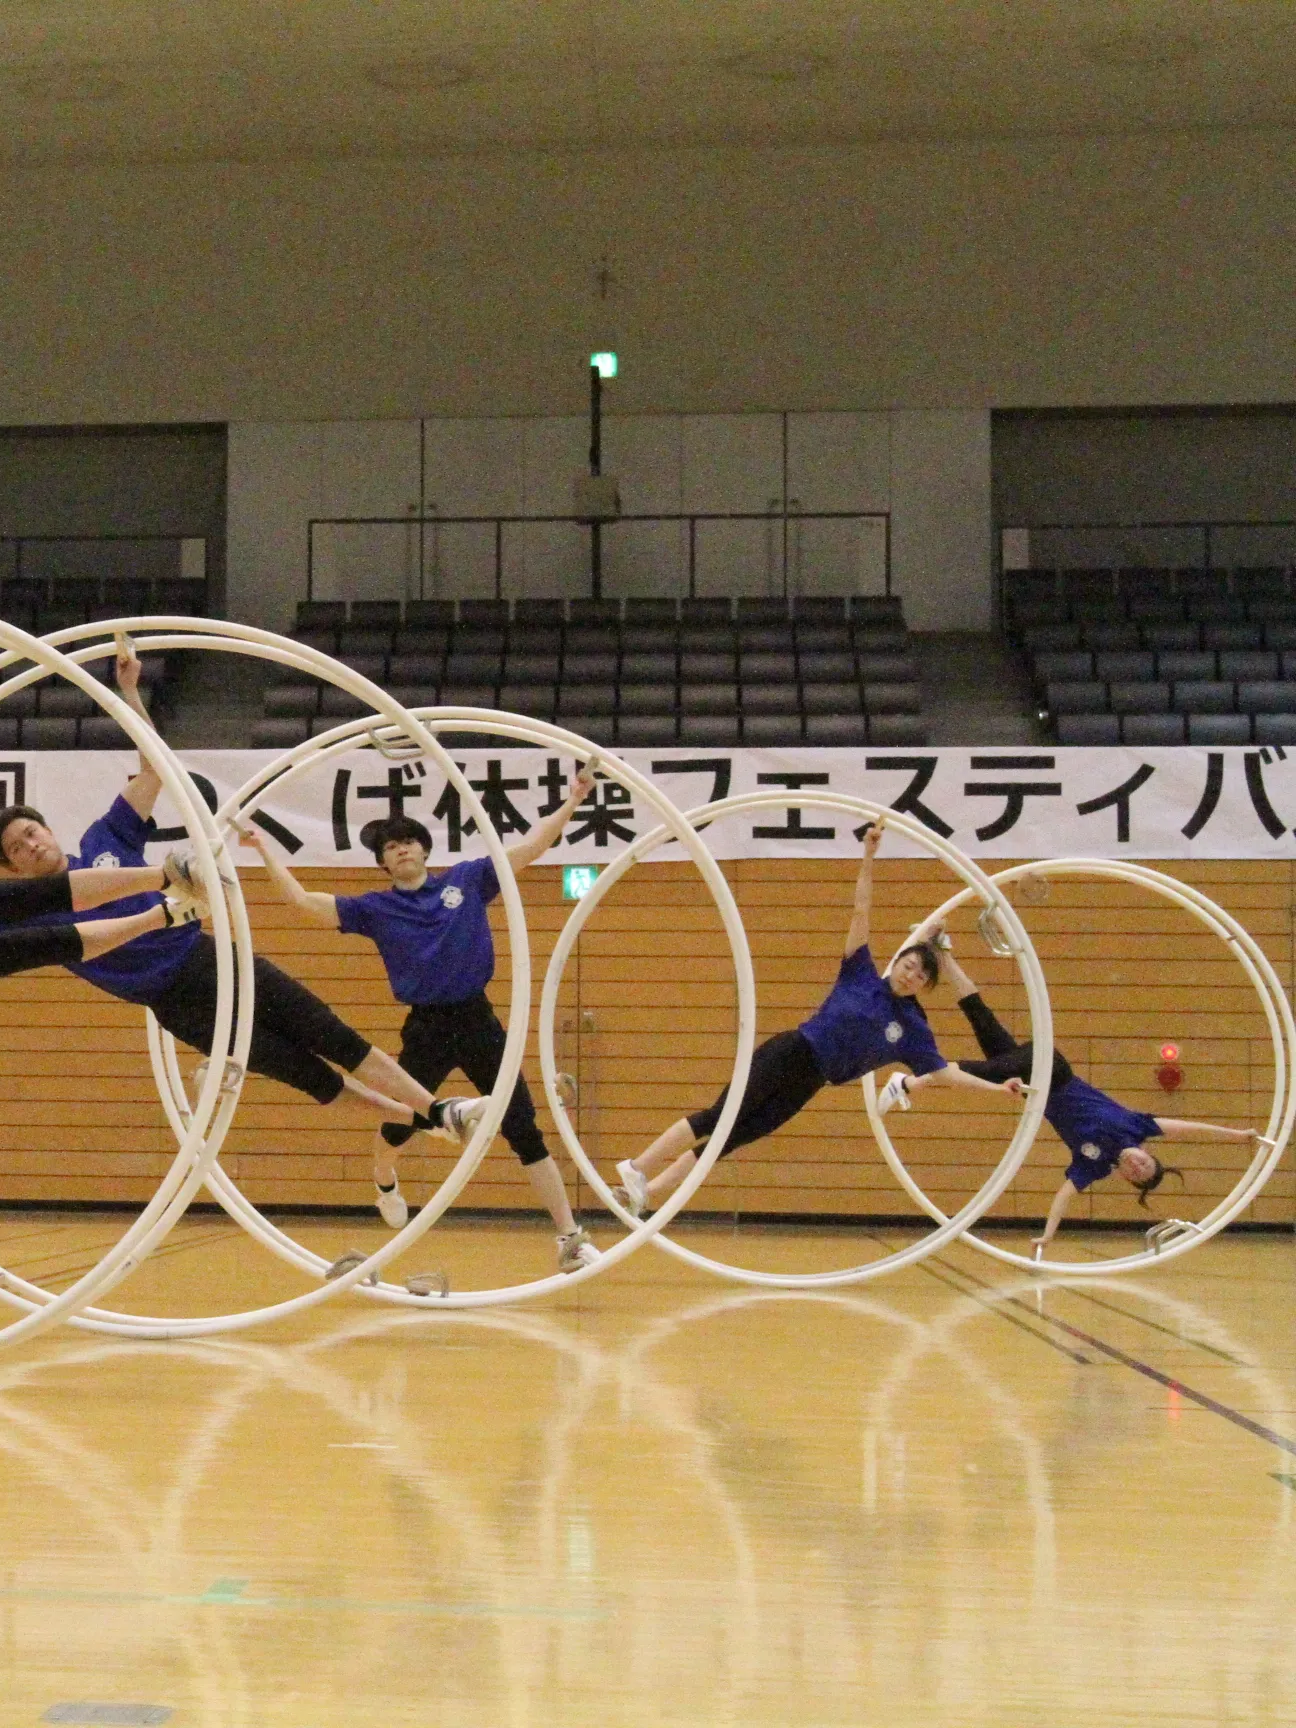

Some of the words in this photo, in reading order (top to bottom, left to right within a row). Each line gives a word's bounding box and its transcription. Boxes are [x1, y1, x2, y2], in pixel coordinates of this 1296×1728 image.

[128, 746, 1296, 855] くば体操フェスティバ
